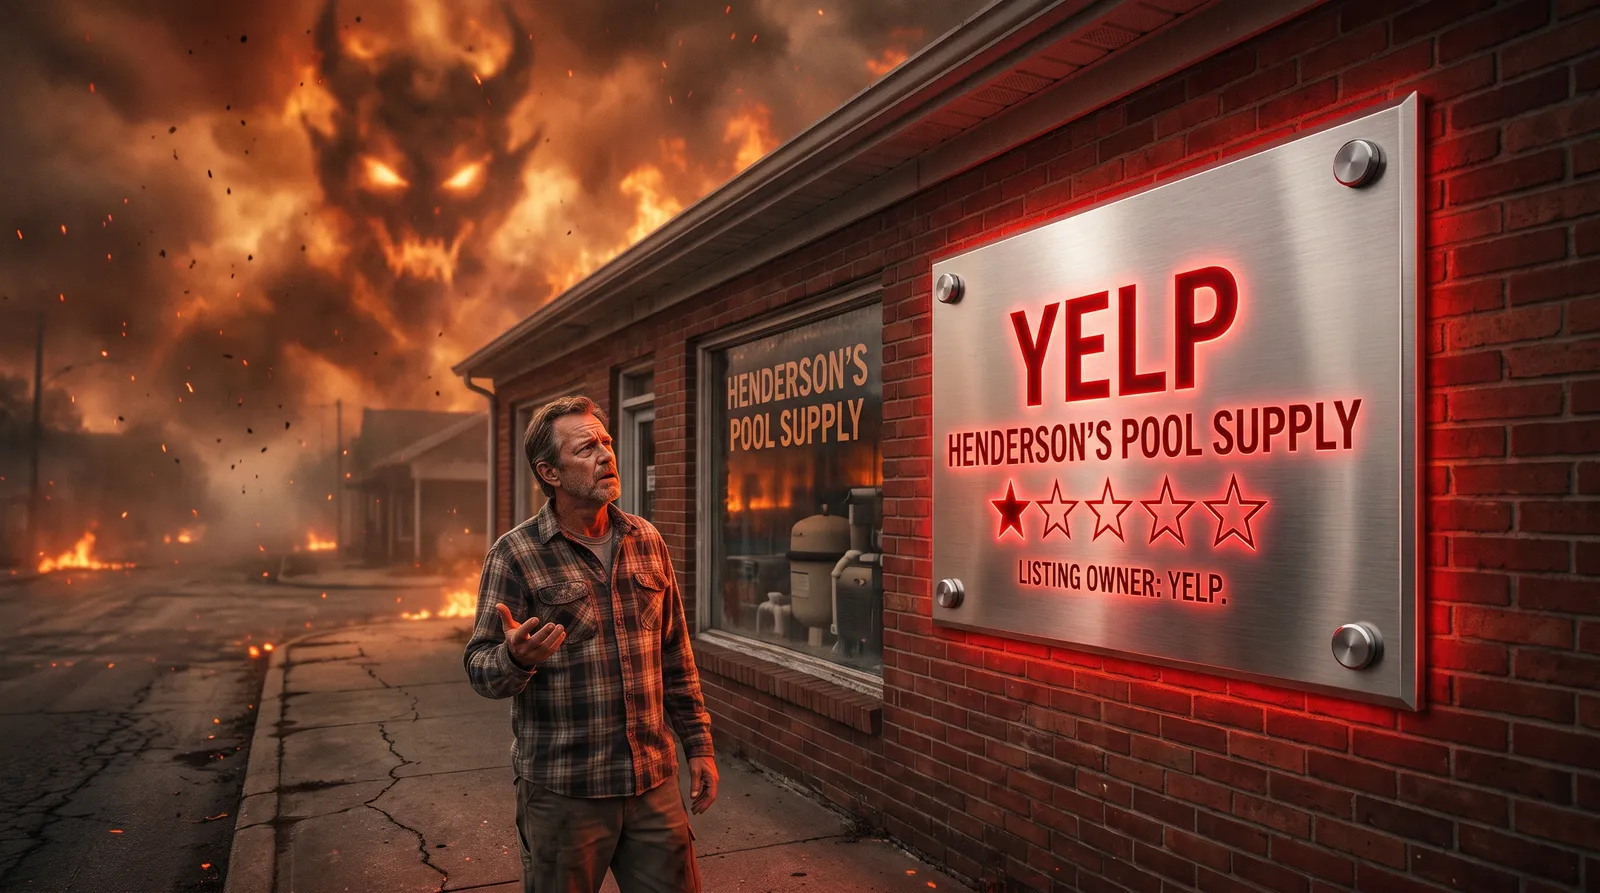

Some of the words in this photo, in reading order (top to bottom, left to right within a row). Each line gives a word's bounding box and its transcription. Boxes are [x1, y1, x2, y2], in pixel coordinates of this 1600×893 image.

[1010, 266, 1238, 406] YELP
[728, 343, 868, 409] HENDERSON'S
[730, 413, 775, 452] POOL
[780, 398, 864, 447] SUPPLY
[948, 421, 1112, 467] HENDERSON'S
[1121, 414, 1202, 459] POOL
[1212, 399, 1362, 454] SUPPLY
[1018, 560, 1081, 591] LISTING
[1086, 567, 1161, 599] OWNER:
[1168, 571, 1228, 605] YELP.
